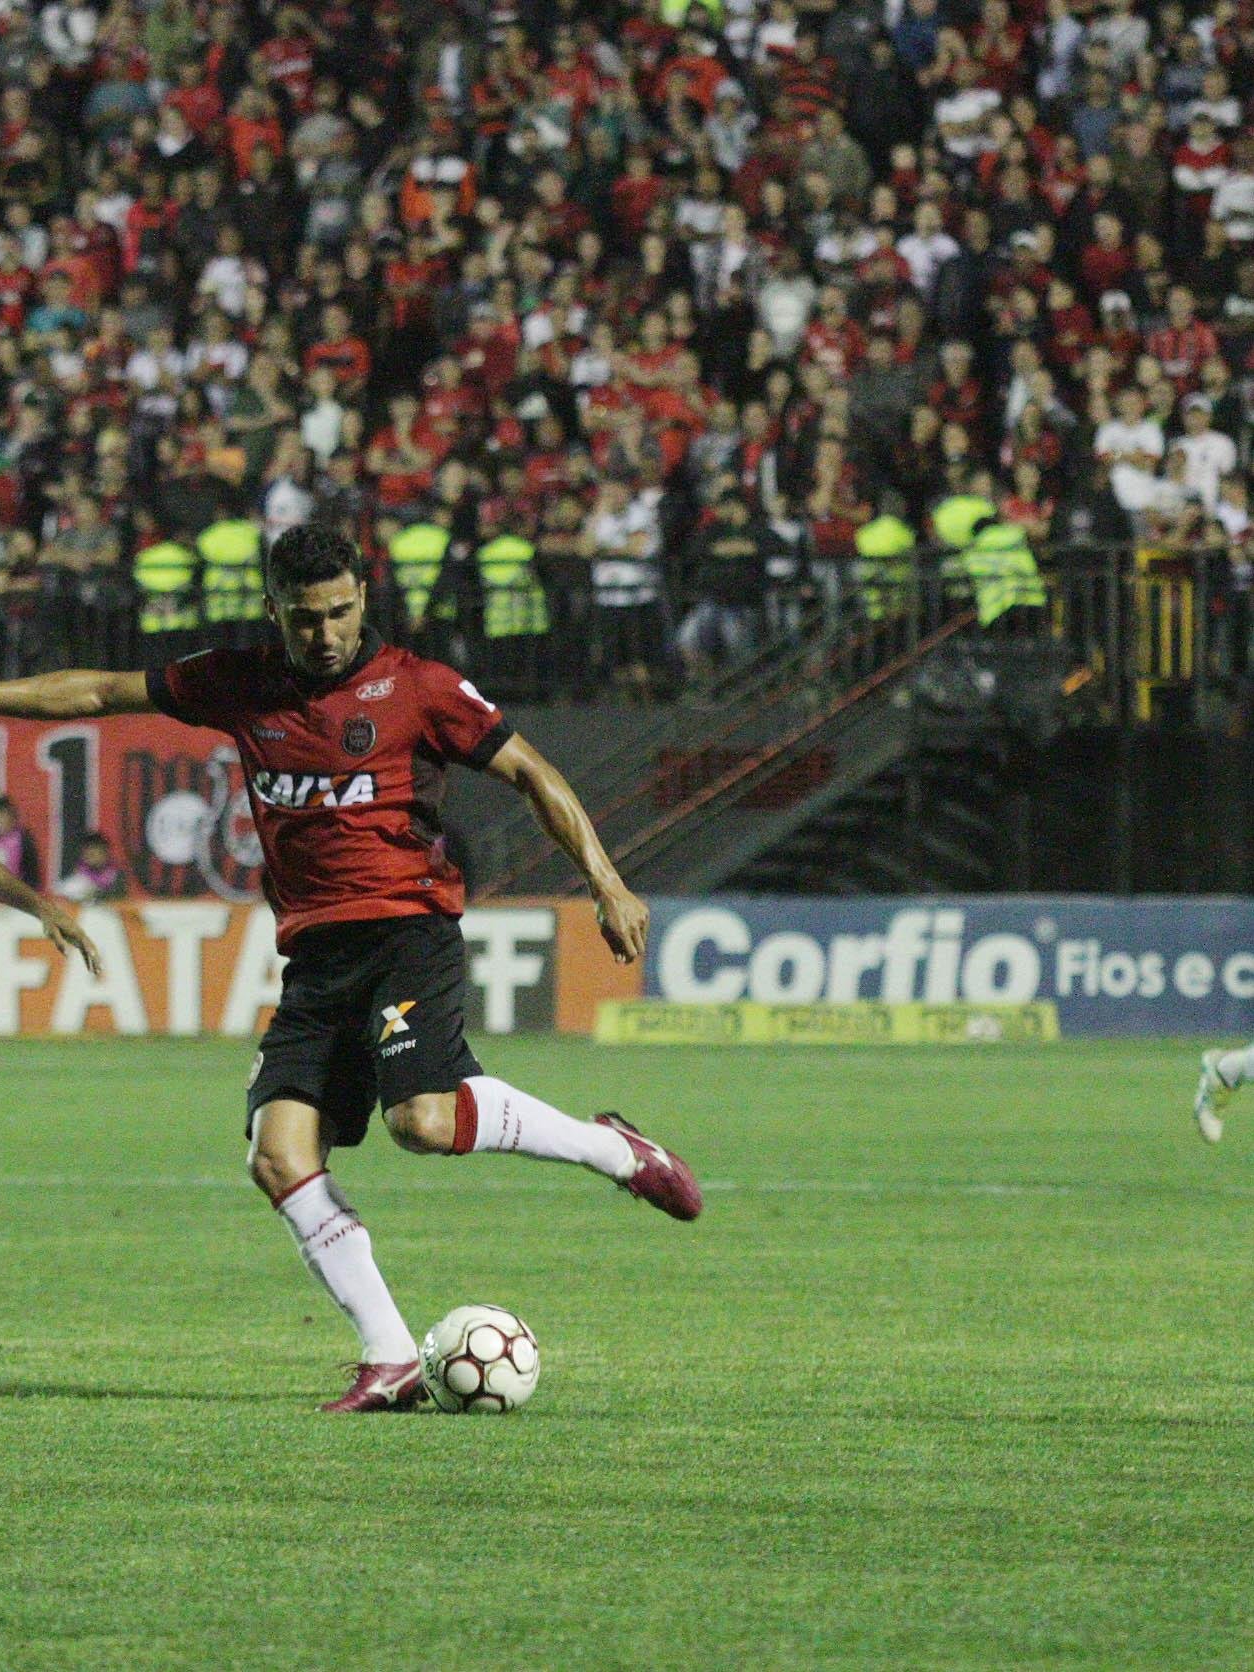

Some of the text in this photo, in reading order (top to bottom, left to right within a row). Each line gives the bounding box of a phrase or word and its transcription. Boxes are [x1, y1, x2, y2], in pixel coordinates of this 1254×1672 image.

[657, 907, 1044, 1004] Corfio
[1056, 938, 1254, 999] Fios e c
[381, 1039, 417, 1058] Topper
